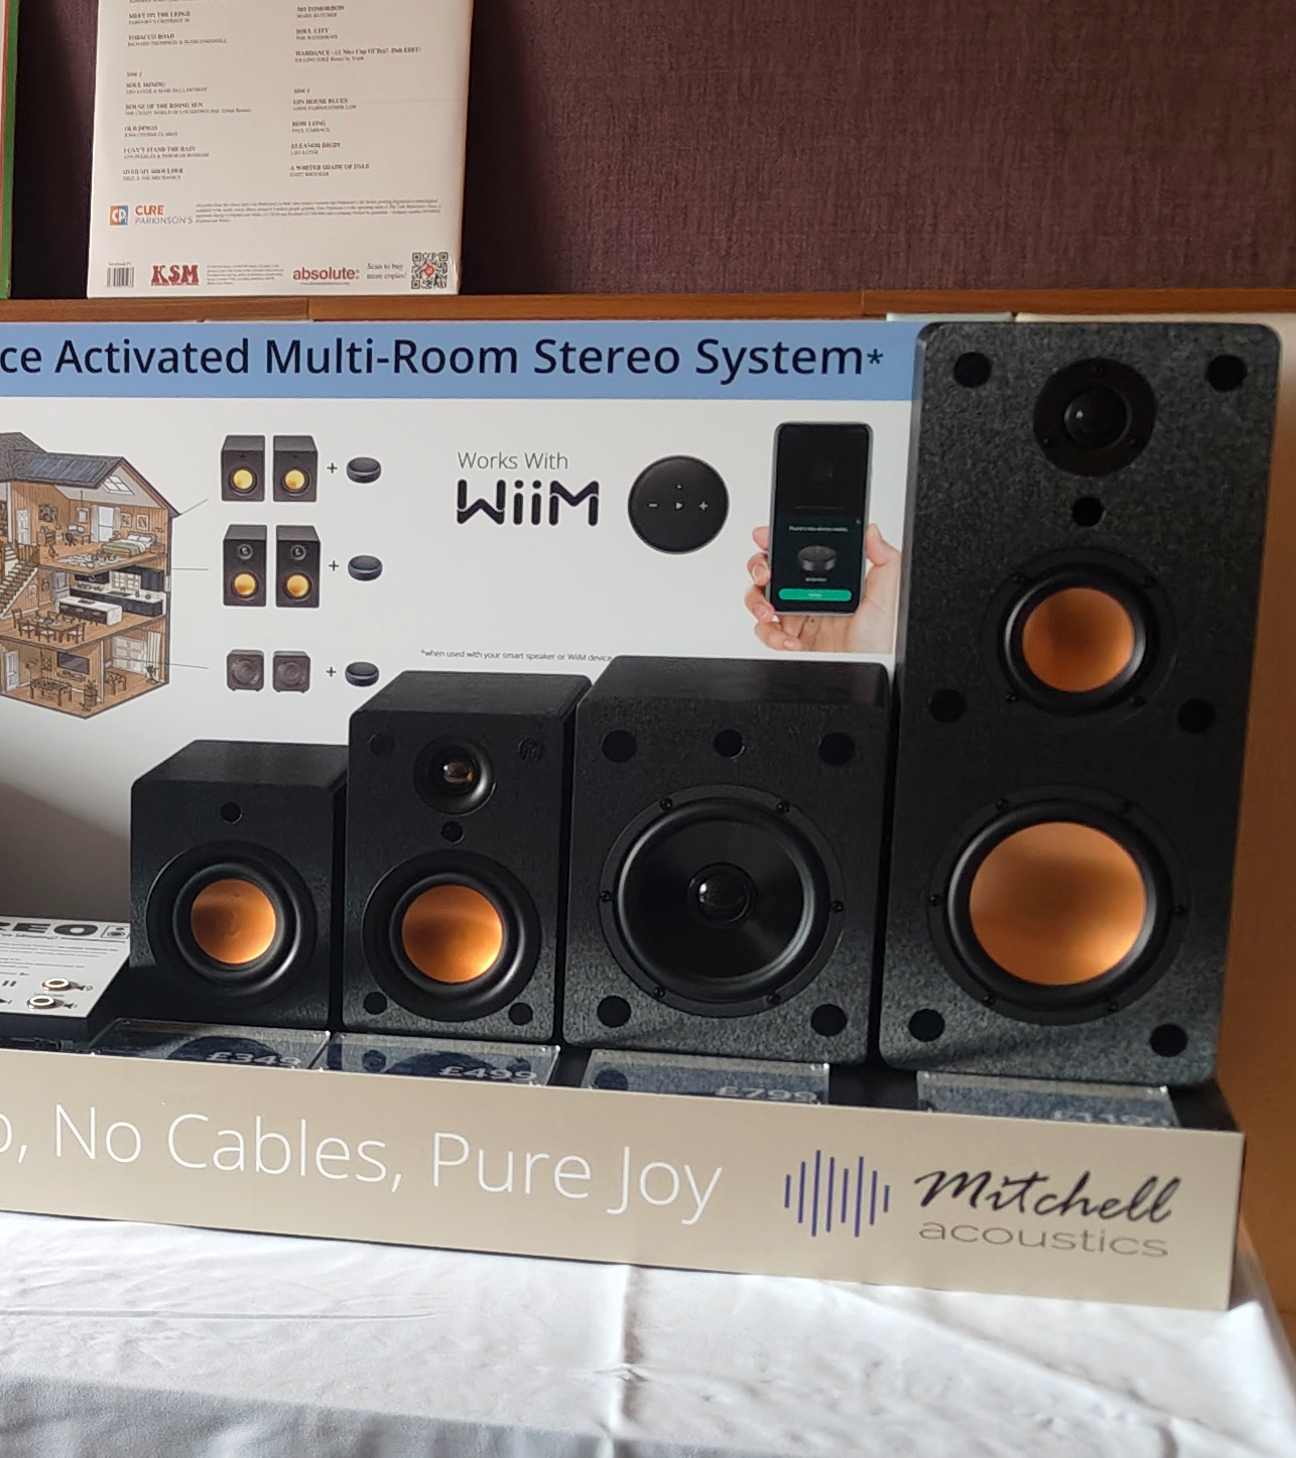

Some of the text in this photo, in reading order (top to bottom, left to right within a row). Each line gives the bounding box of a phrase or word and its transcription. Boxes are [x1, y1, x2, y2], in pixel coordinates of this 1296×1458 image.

[135, 205, 165, 215] CURE
[151, 264, 200, 286] KSM
[293, 266, 361, 281] absolute:
[55, 338, 250, 374] Activated
[265, 338, 518, 375] Multi-Room
[533, 339, 681, 375] Stereo
[457, 451, 569, 470] Works With
[457, 479, 599, 526] WiiM
[447, 650, 465, 658] used
[467, 650, 482, 659] with
[483, 652, 500, 661] your
[503, 651, 524, 660] smart
[526, 652, 555, 662] speaker
[439, 1066, 537, 1081] £499
[55, 1104, 144, 1164] No
[167, 1113, 404, 1193] Cables,
[432, 1131, 593, 1200] Pure
[607, 1144, 724, 1227] Joy
[915, 1168, 1184, 1225] Mitchell
[918, 1221, 1171, 1260] acoustics
